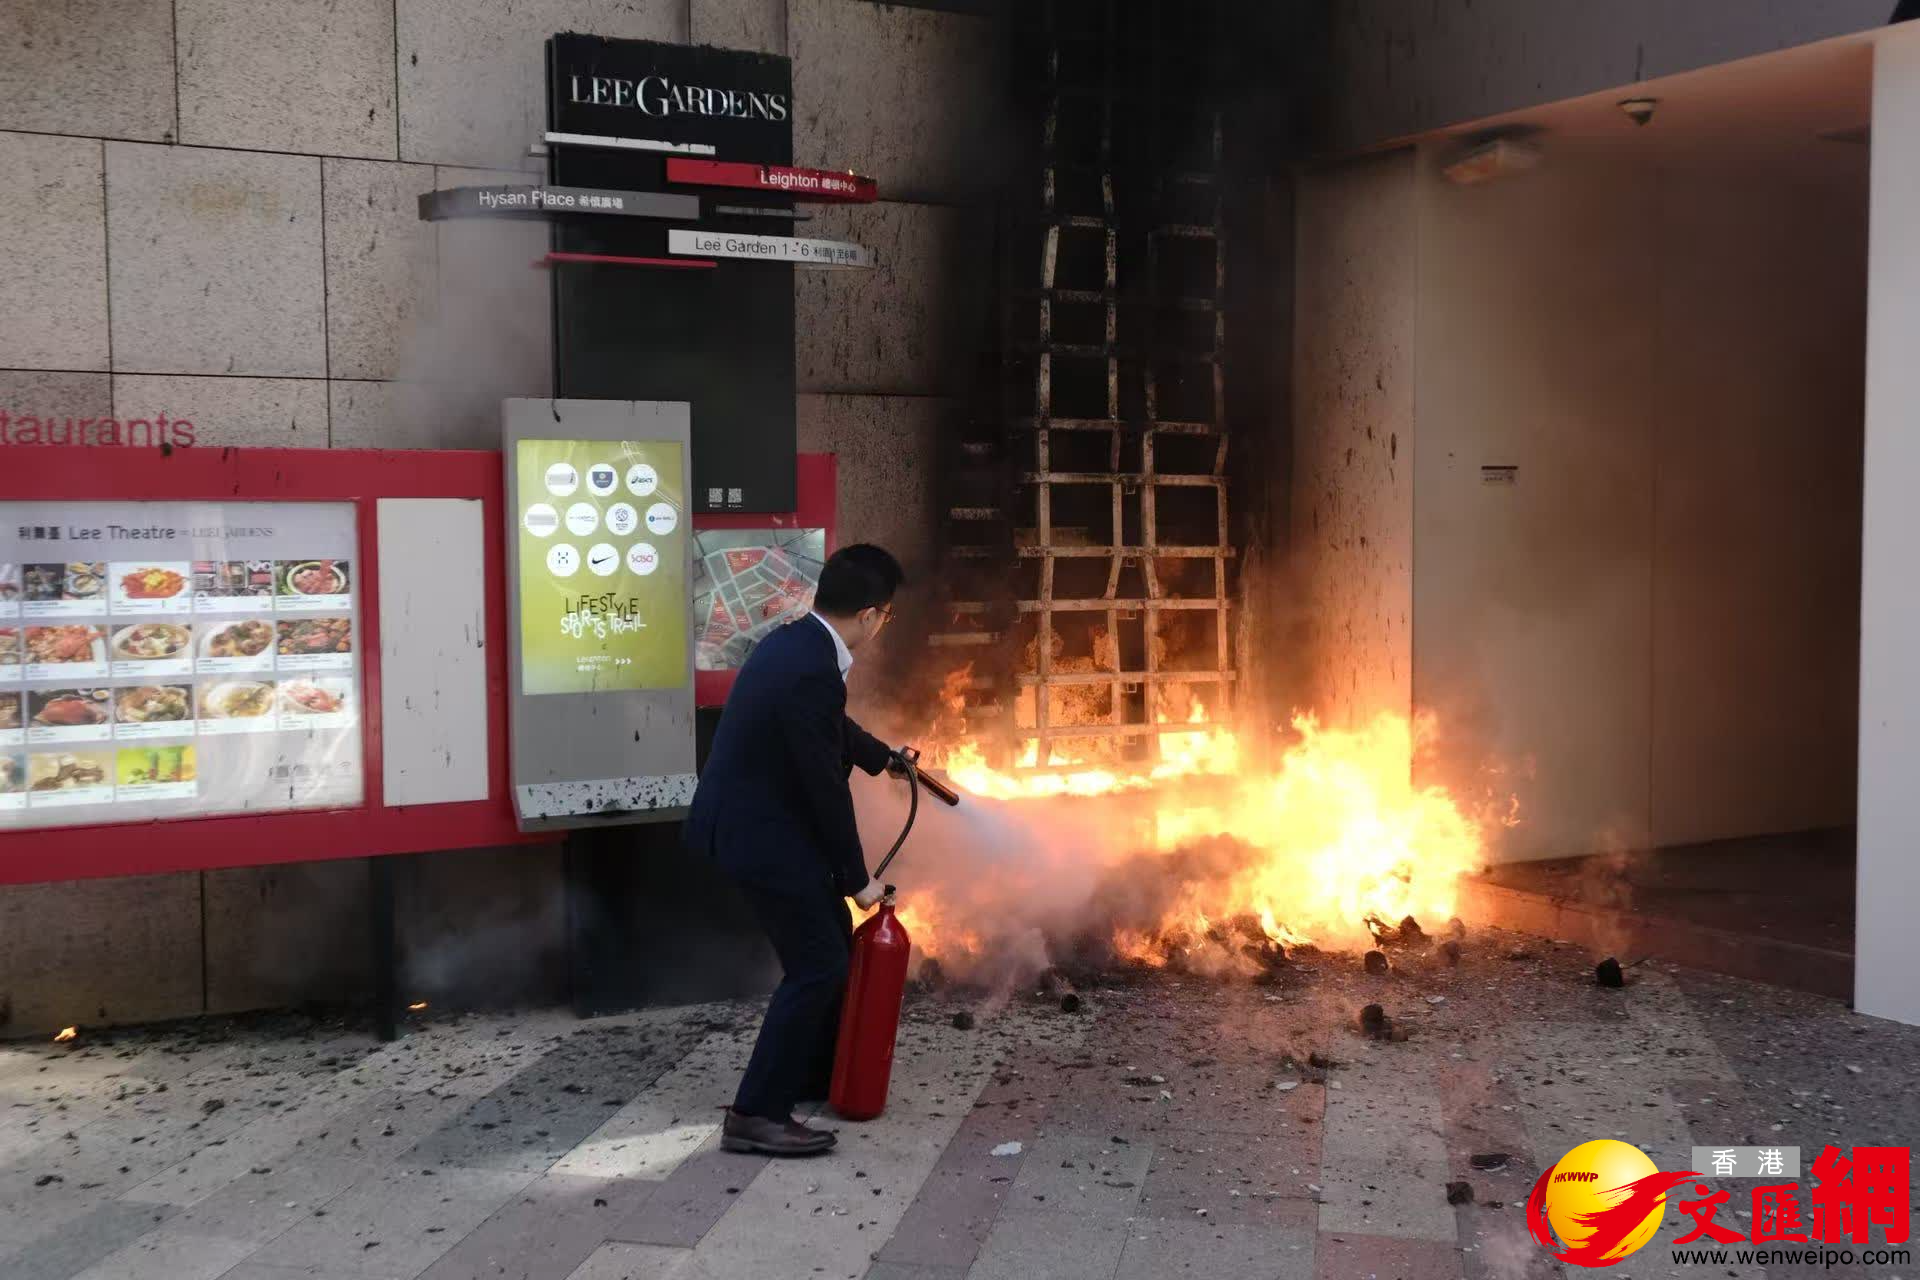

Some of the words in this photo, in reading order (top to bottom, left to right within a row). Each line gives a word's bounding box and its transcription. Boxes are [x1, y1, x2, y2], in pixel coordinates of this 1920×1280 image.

[760, 170, 818, 189] Leighton
[478, 191, 527, 208] Hysan
[531, 191, 575, 207] Place
[695, 237, 721, 251] Lee
[726, 238, 777, 255] Garden
[68, 526, 102, 540] Lee
[106, 525, 177, 541] Theatre
[560, 609, 606, 639] SPORTS
[607, 611, 648, 635] TRAIL
